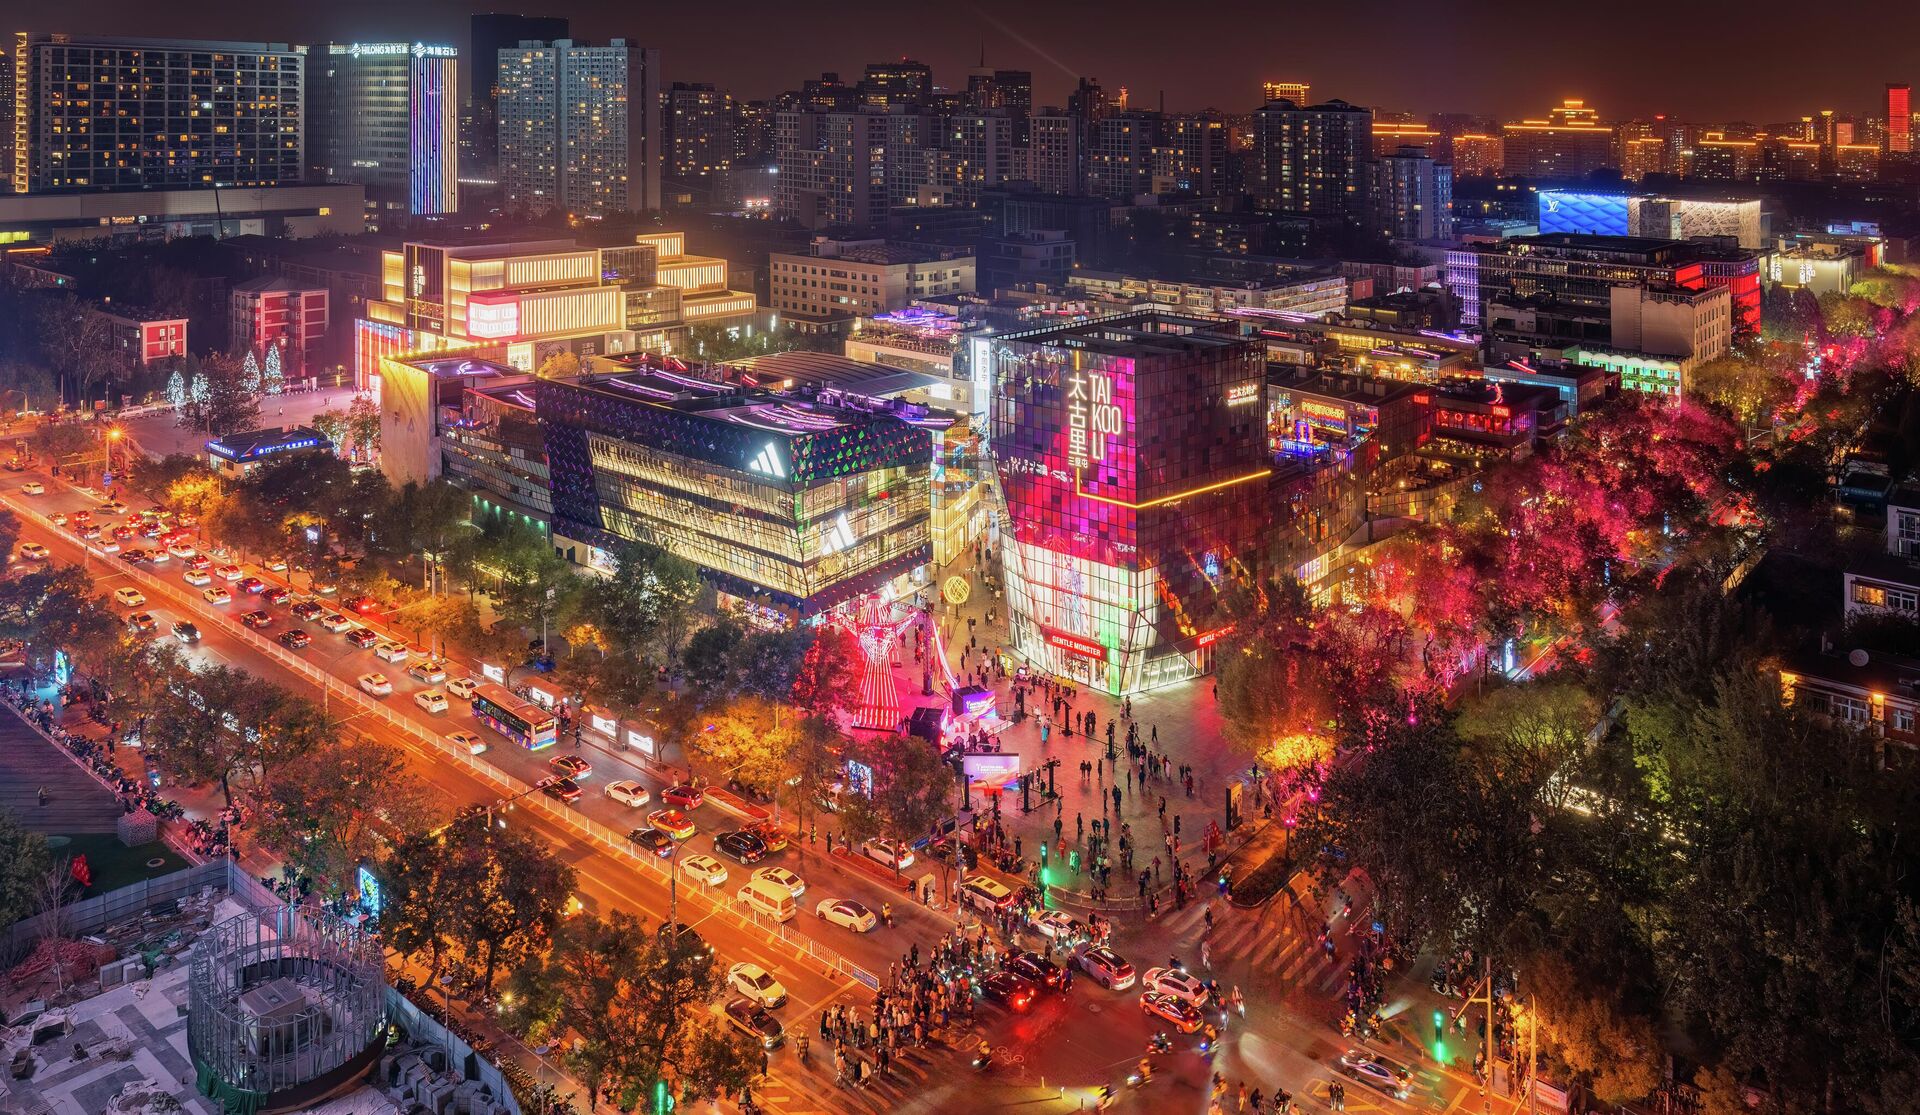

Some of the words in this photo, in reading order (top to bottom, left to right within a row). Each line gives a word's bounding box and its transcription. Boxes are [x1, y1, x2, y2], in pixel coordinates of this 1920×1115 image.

[361, 45, 384, 54] HILONG
[1089, 375, 1111, 405] TAI
[1068, 372, 1088, 457] 太古里
[1092, 403, 1122, 435] KOO
[1092, 431, 1104, 461] LI
[1052, 635, 1073, 648] GENTLE
[1073, 642, 1101, 656] MONSTER
